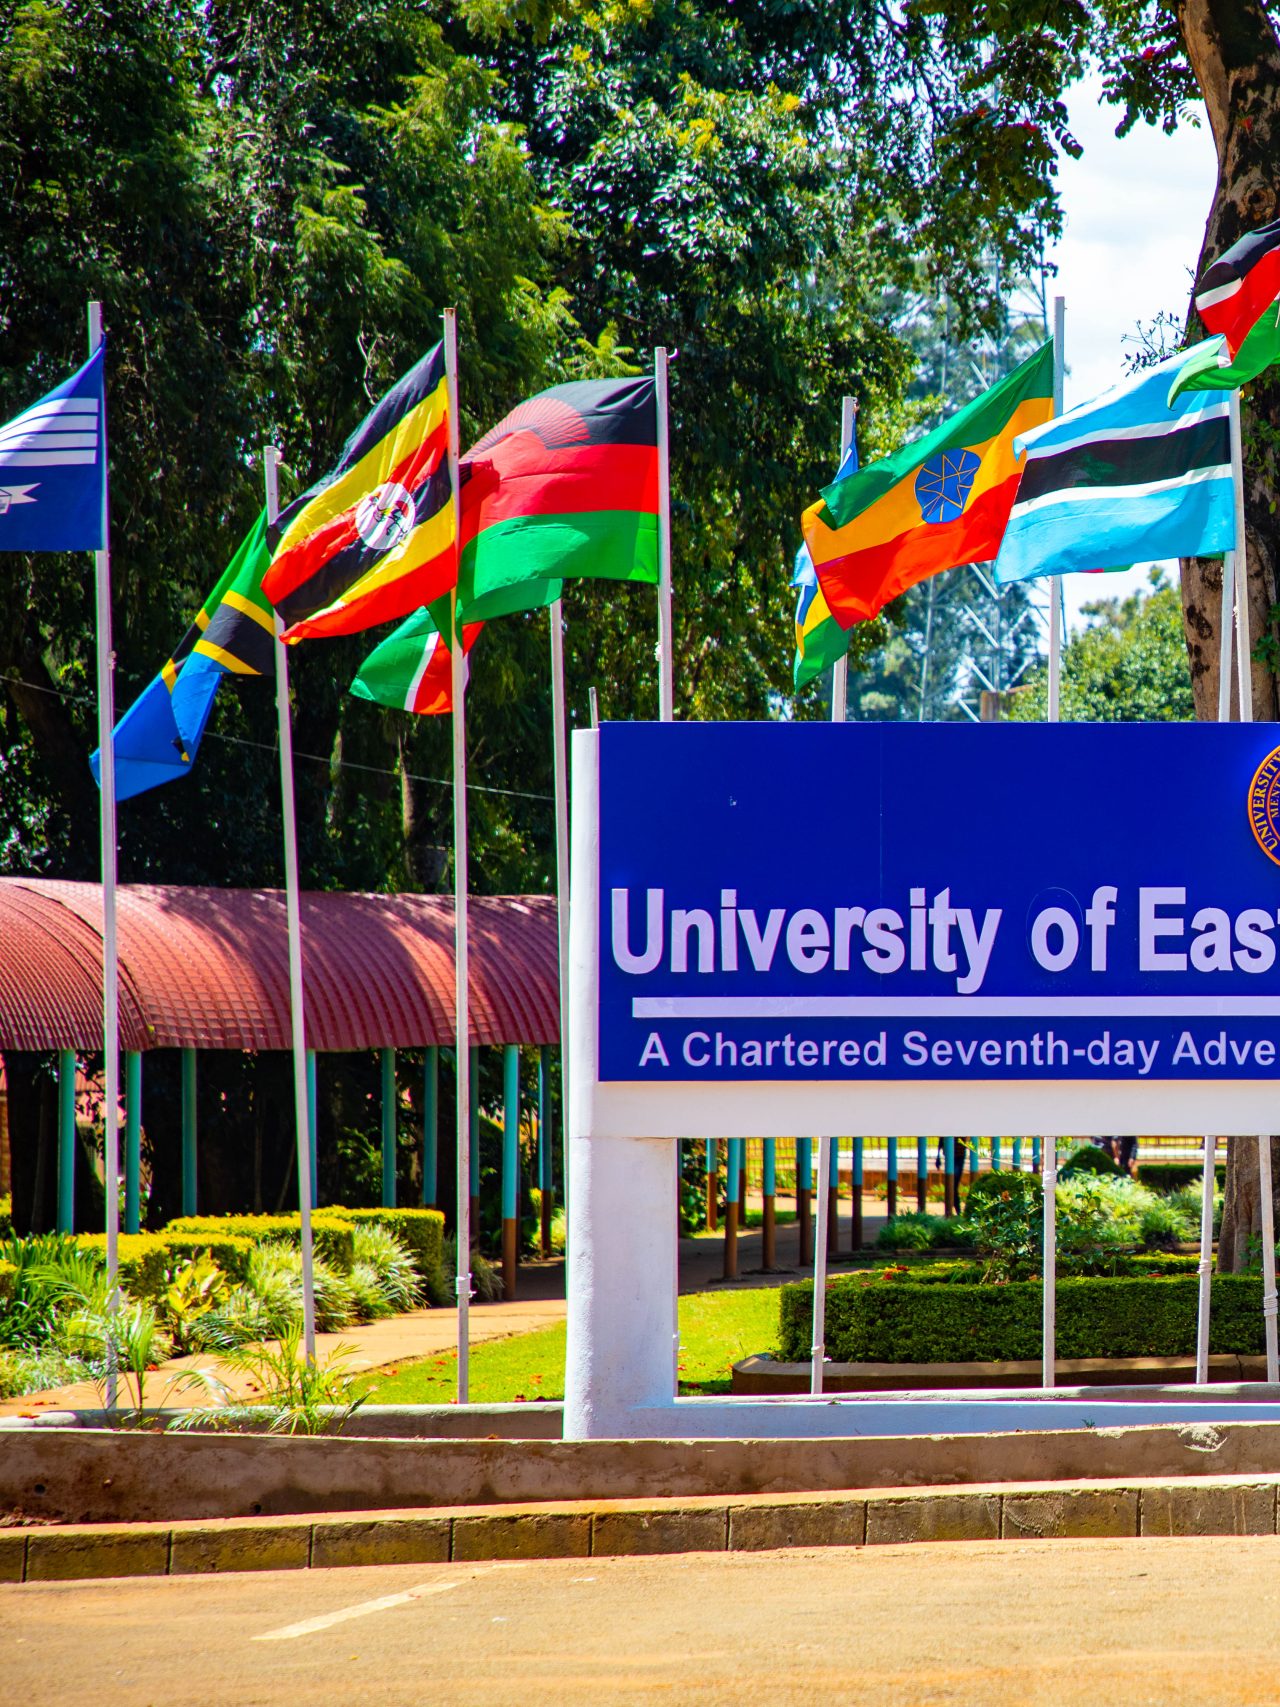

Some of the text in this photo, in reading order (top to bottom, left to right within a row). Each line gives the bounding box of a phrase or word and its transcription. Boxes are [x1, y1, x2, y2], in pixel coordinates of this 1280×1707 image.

[611, 887, 1003, 994] University
[1031, 885, 1118, 972] of
[638, 1032, 669, 1067] A
[682, 1031, 886, 1067] Chartered
[902, 1031, 1160, 1075] Seventh-day
